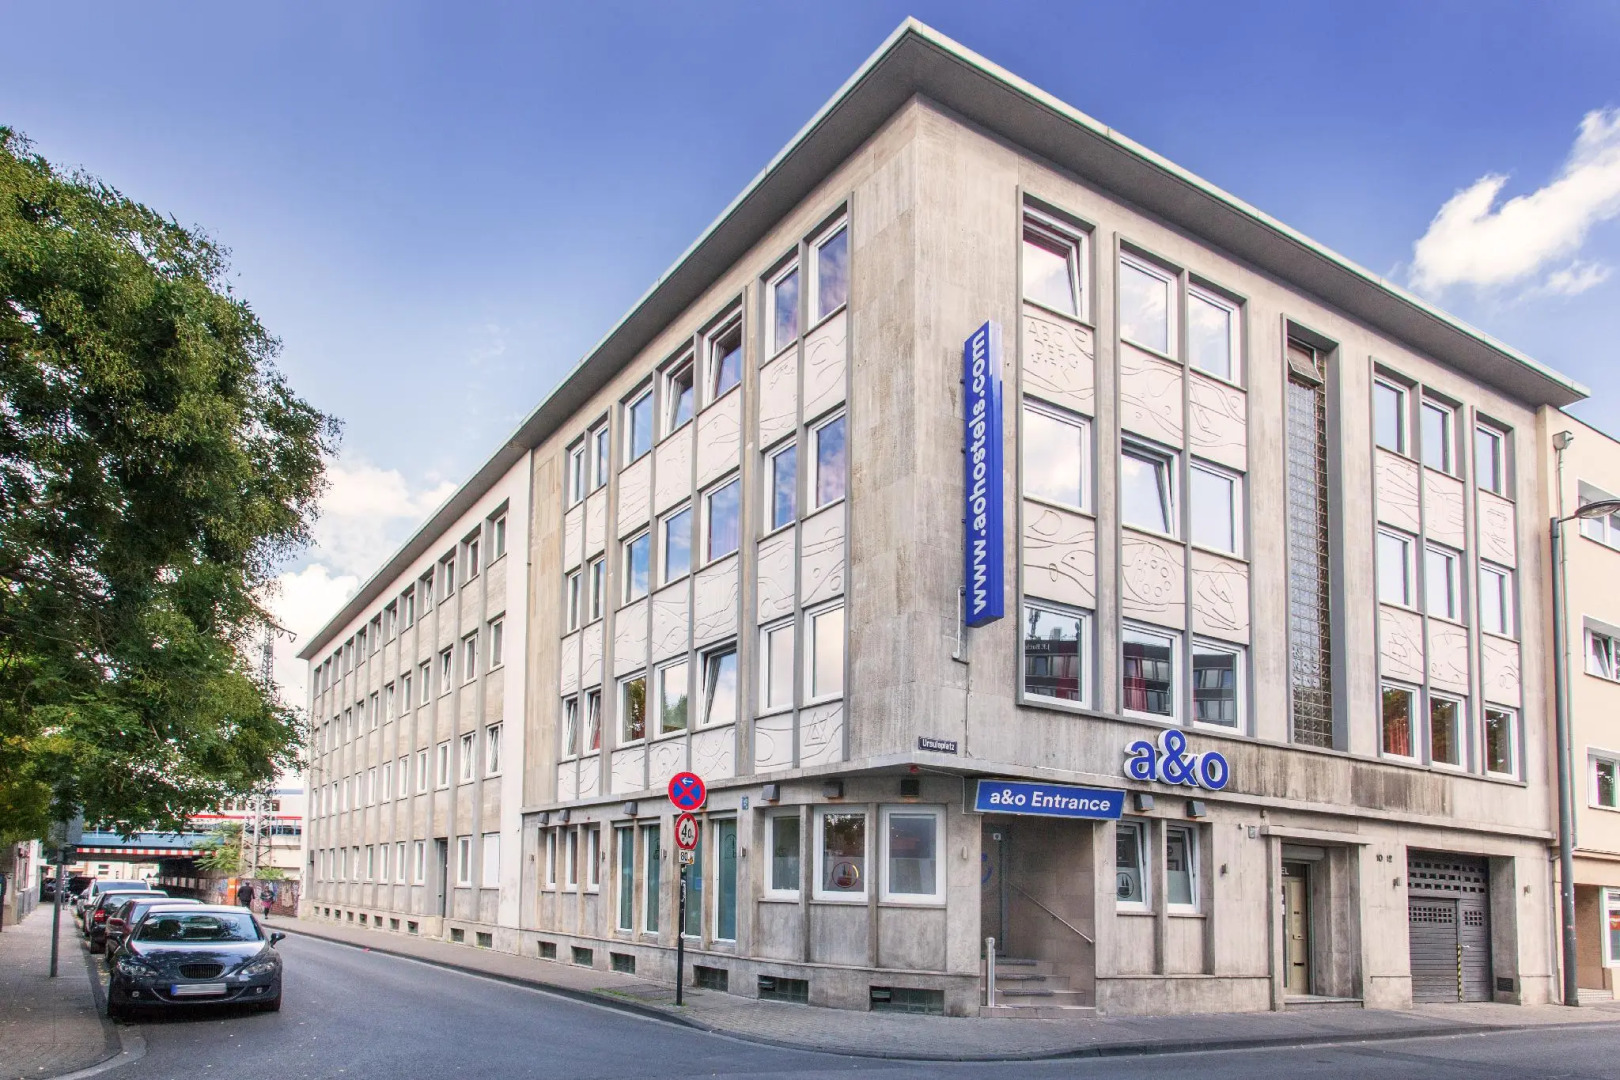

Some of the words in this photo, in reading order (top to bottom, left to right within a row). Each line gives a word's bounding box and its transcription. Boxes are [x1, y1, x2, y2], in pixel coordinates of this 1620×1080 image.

[969, 330, 986, 615] www.aohostels.com
[1124, 728, 1229, 791] a&o
[989, 789, 1026, 806] a&o
[1031, 791, 1111, 811] Entrance
